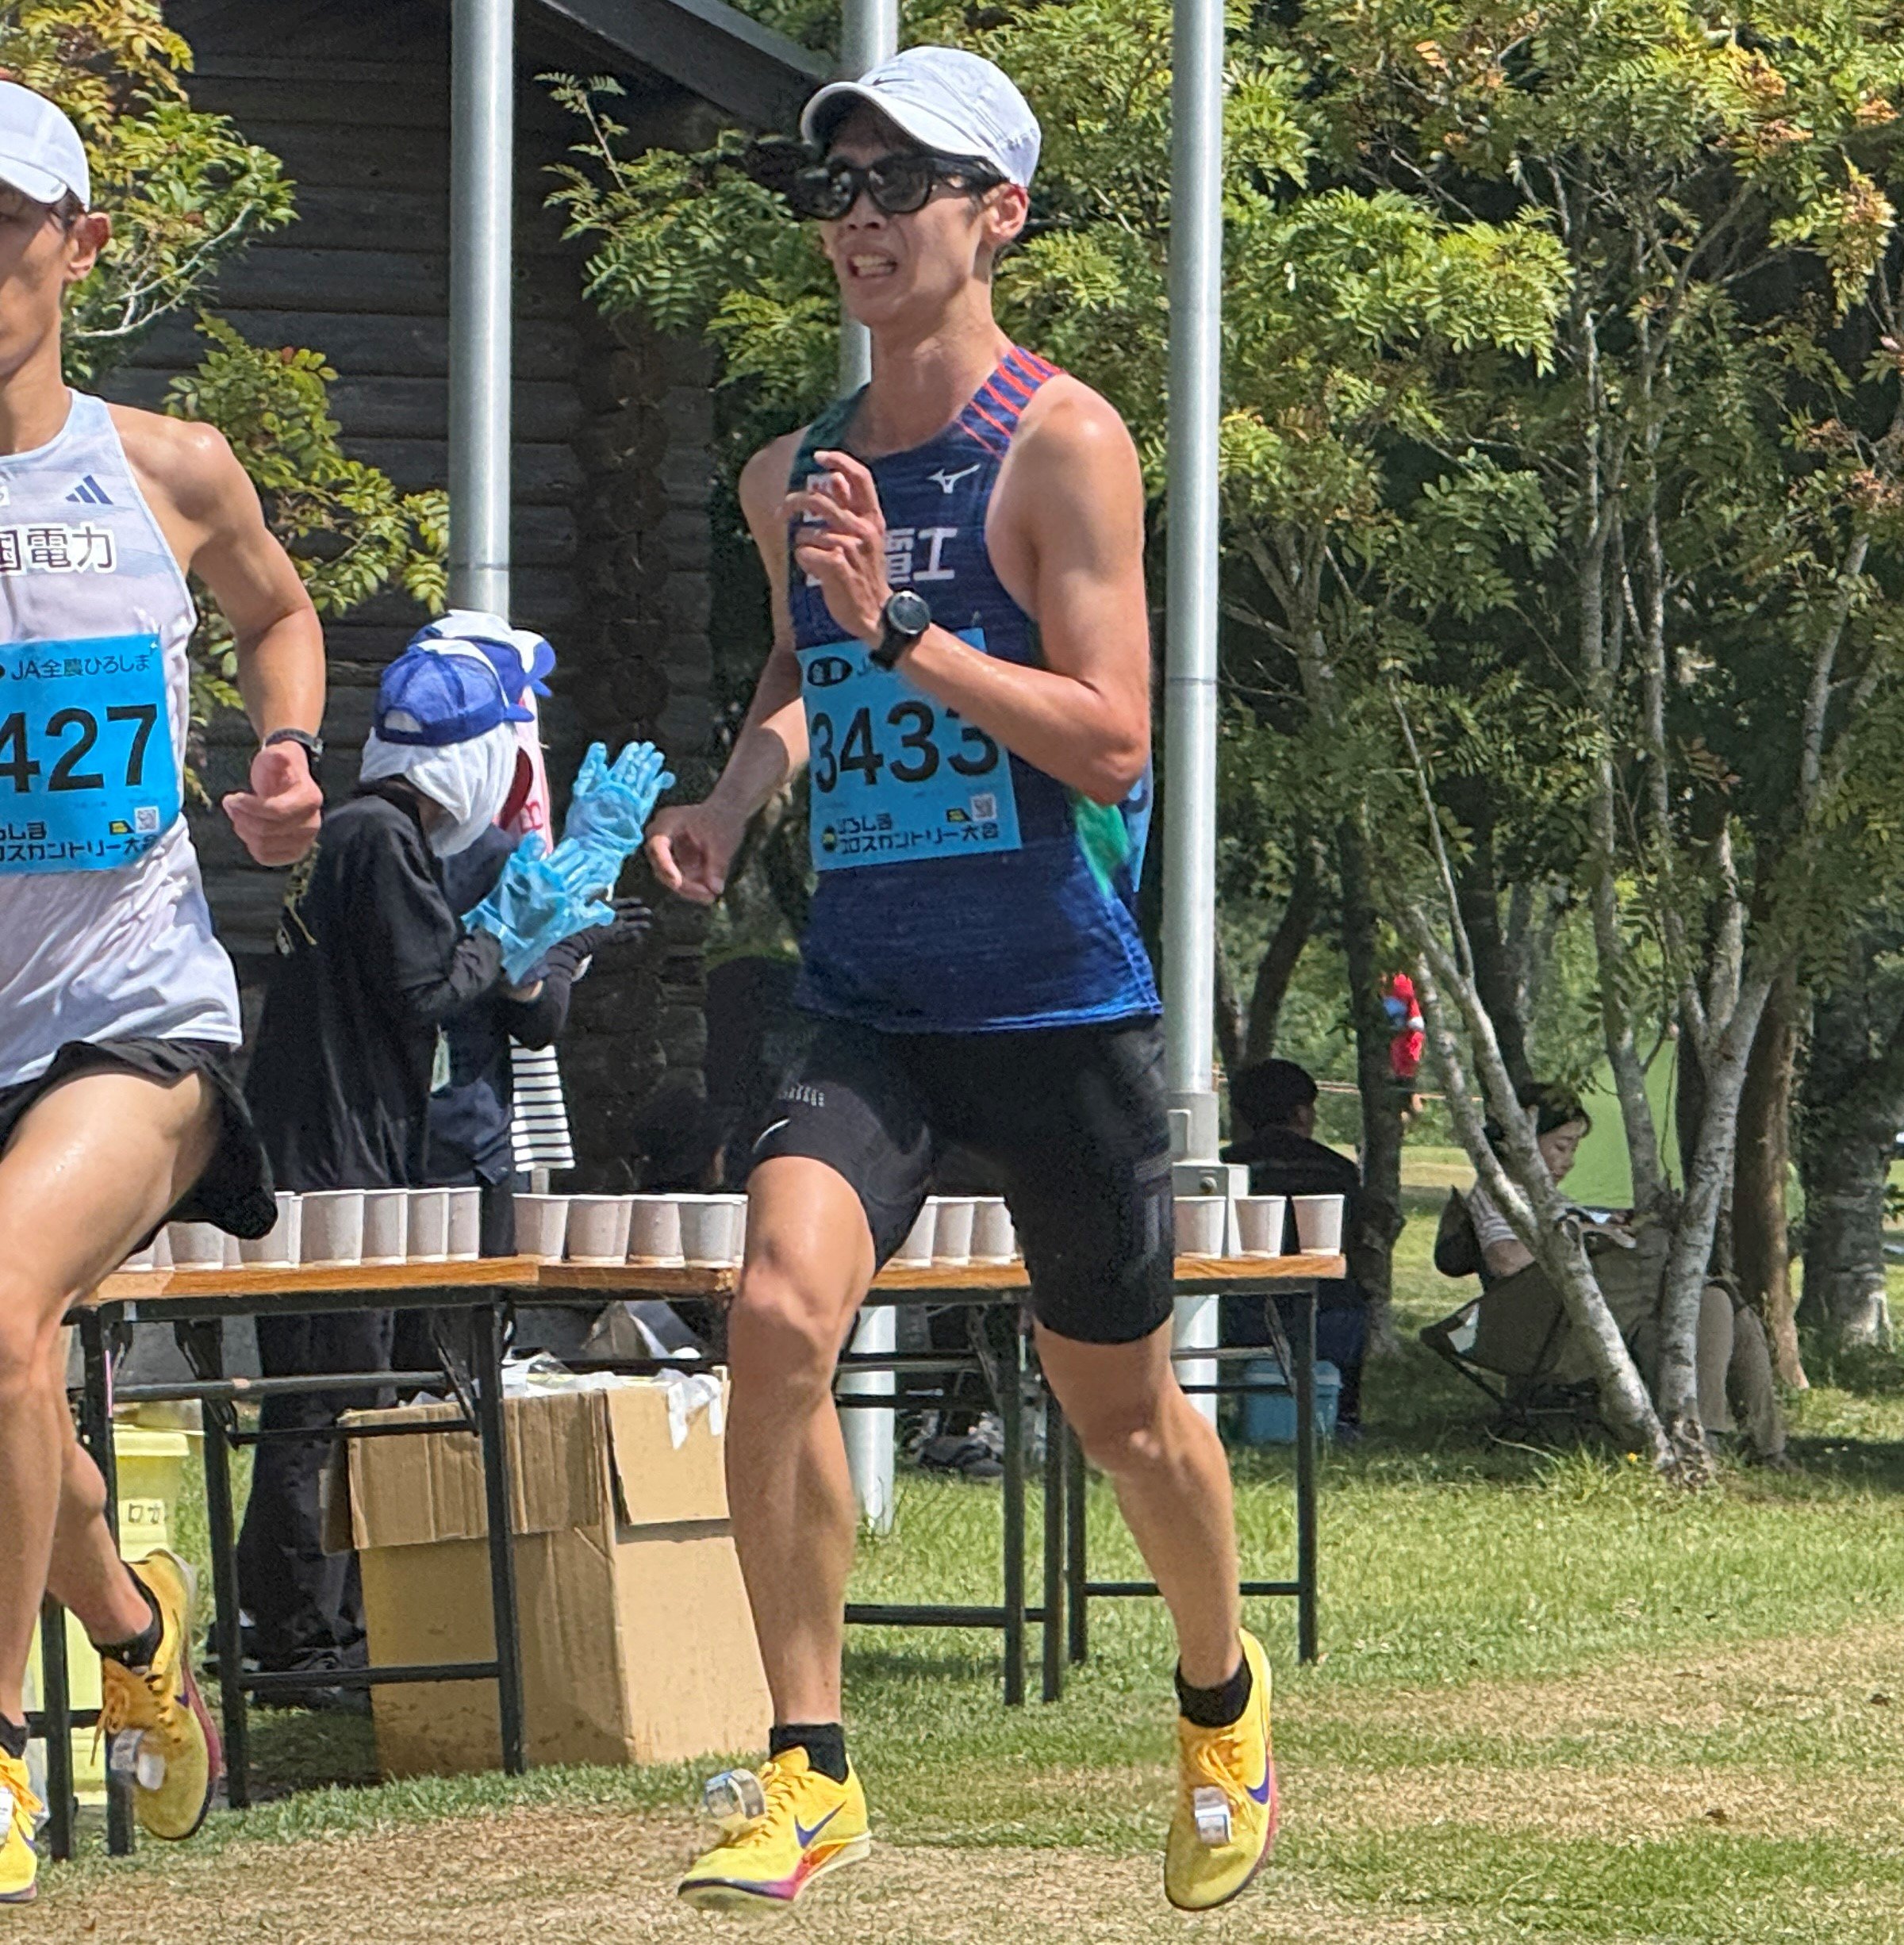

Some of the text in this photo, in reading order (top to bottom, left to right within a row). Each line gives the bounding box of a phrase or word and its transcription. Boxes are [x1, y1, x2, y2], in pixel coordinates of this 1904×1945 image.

[11, 655, 151, 681] JA全農ひろしま
[0, 703, 157, 792] 427
[811, 700, 999, 793] 3433
[0, 820, 46, 841] しま
